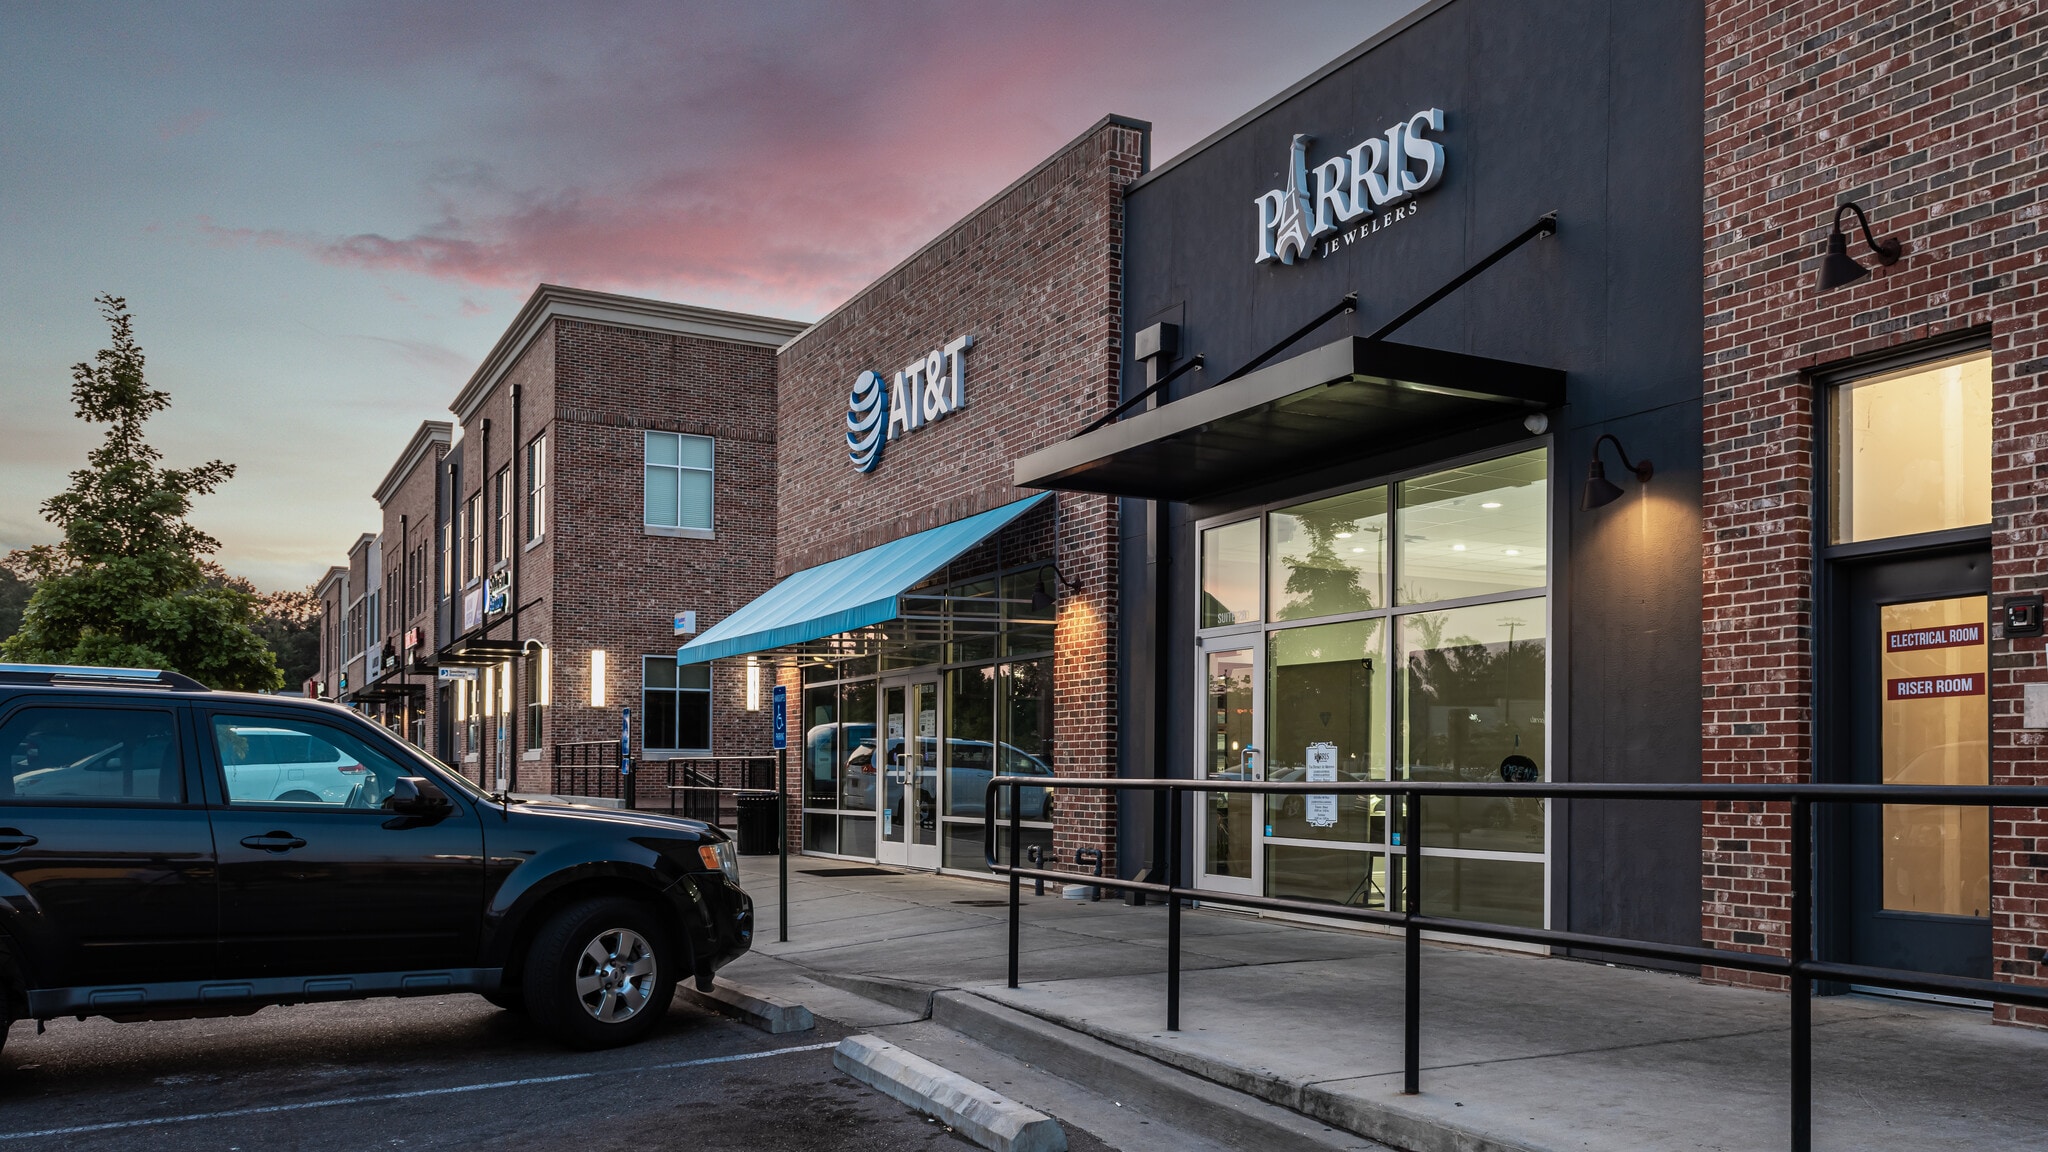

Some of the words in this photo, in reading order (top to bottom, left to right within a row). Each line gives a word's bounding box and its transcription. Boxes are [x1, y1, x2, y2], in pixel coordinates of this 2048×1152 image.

[1254, 107, 1444, 265] PARRIS
[1322, 200, 1418, 258] JEWELERS
[887, 335, 974, 440] AT&T
[1217, 611, 1235, 624] SUITE
[1891, 630, 1947, 648] ELECTRICAL
[1950, 627, 1978, 643] ROOM
[1898, 680, 1933, 695] RISER
[1936, 678, 1972, 692] ROOM
[1503, 763, 1533, 780] OPEN
